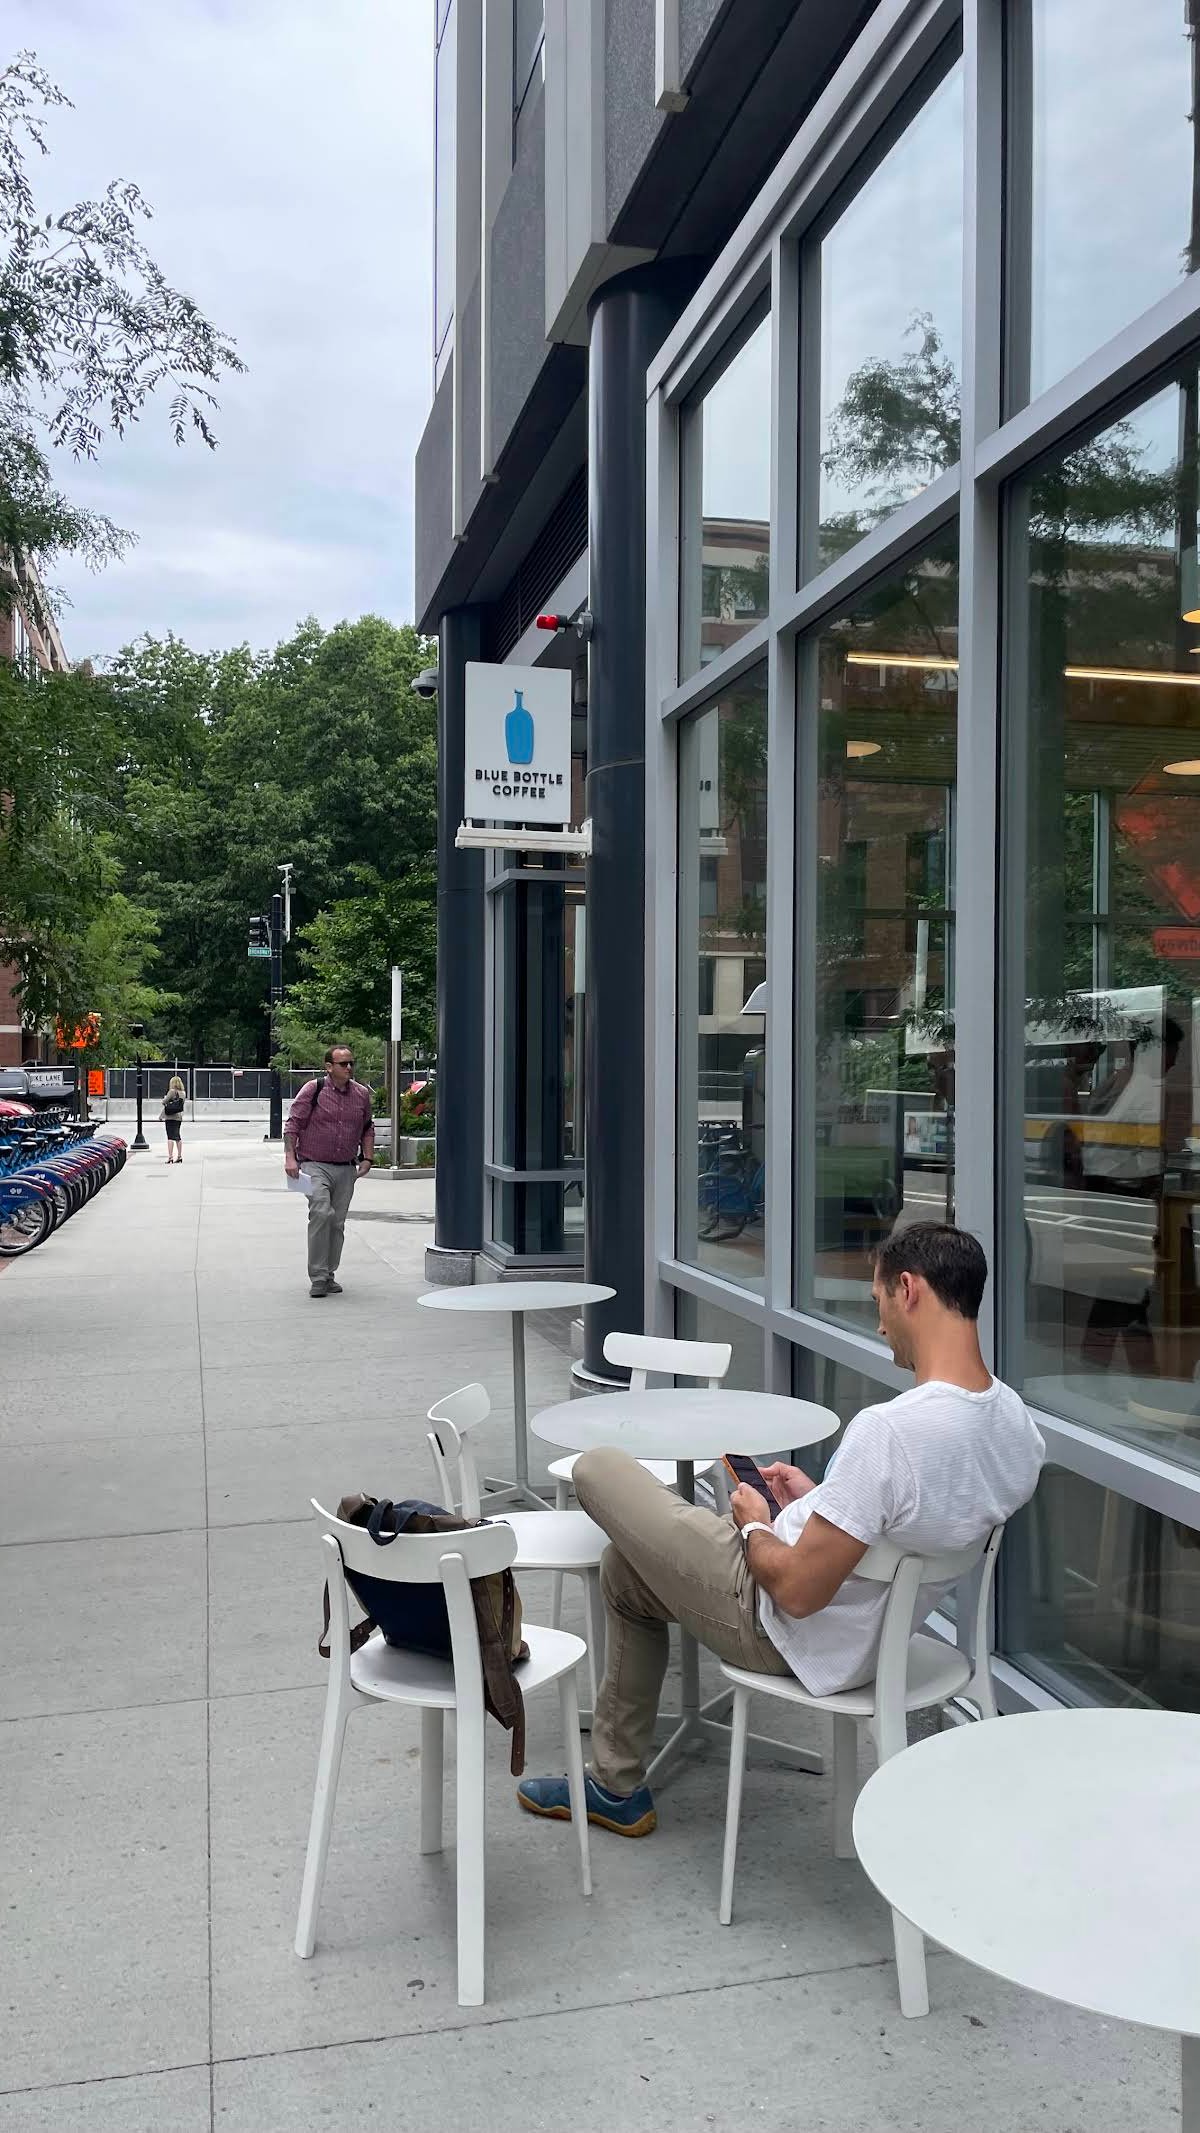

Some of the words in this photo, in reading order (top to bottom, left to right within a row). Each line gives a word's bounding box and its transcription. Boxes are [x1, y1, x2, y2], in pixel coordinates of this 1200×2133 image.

[475, 769, 508, 782] BLUE
[513, 771, 563, 785] BOTTLE
[492, 784, 546, 798] COFFEE
[45, 1074, 61, 1082] LANE
